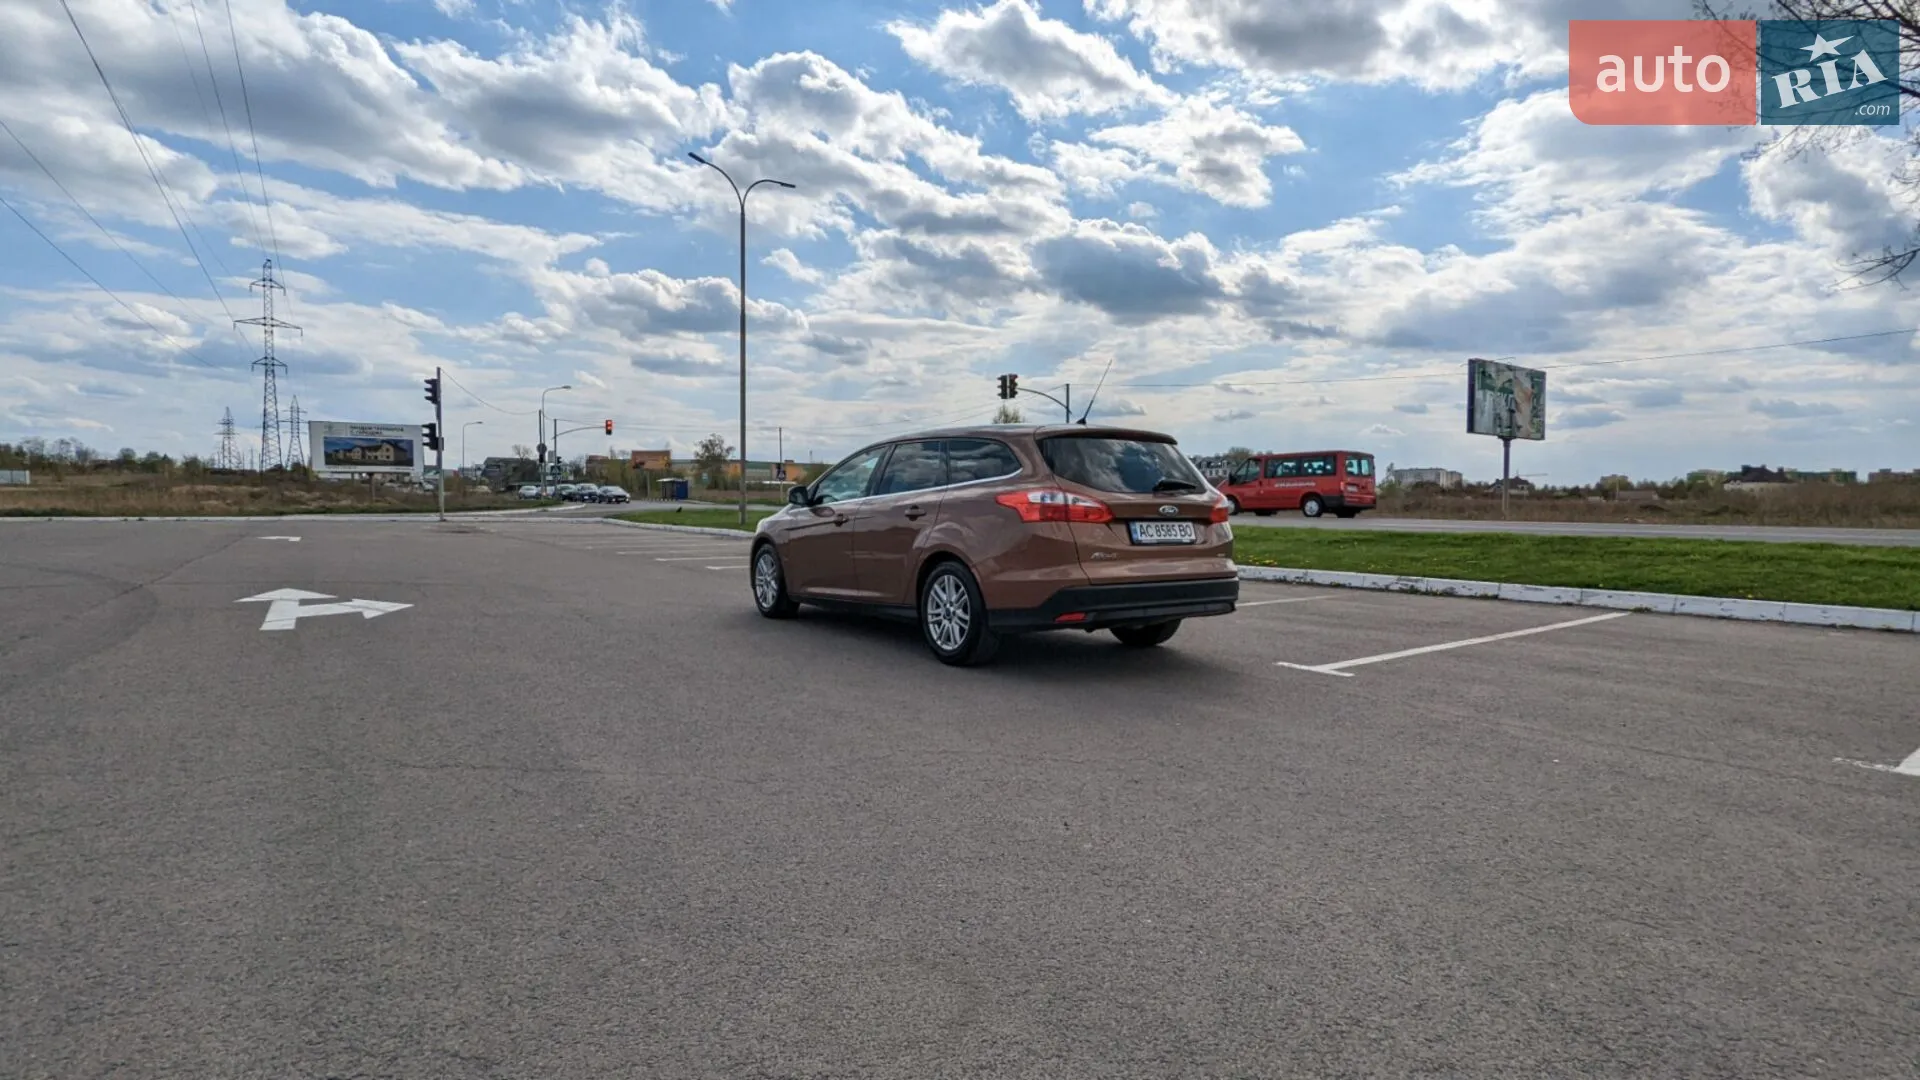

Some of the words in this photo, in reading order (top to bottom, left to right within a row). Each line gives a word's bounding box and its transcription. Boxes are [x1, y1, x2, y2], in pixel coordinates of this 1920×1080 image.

[1139, 523, 1154, 538] AC
[1154, 523, 1178, 538] 8585
[1177, 523, 1193, 538] BO
